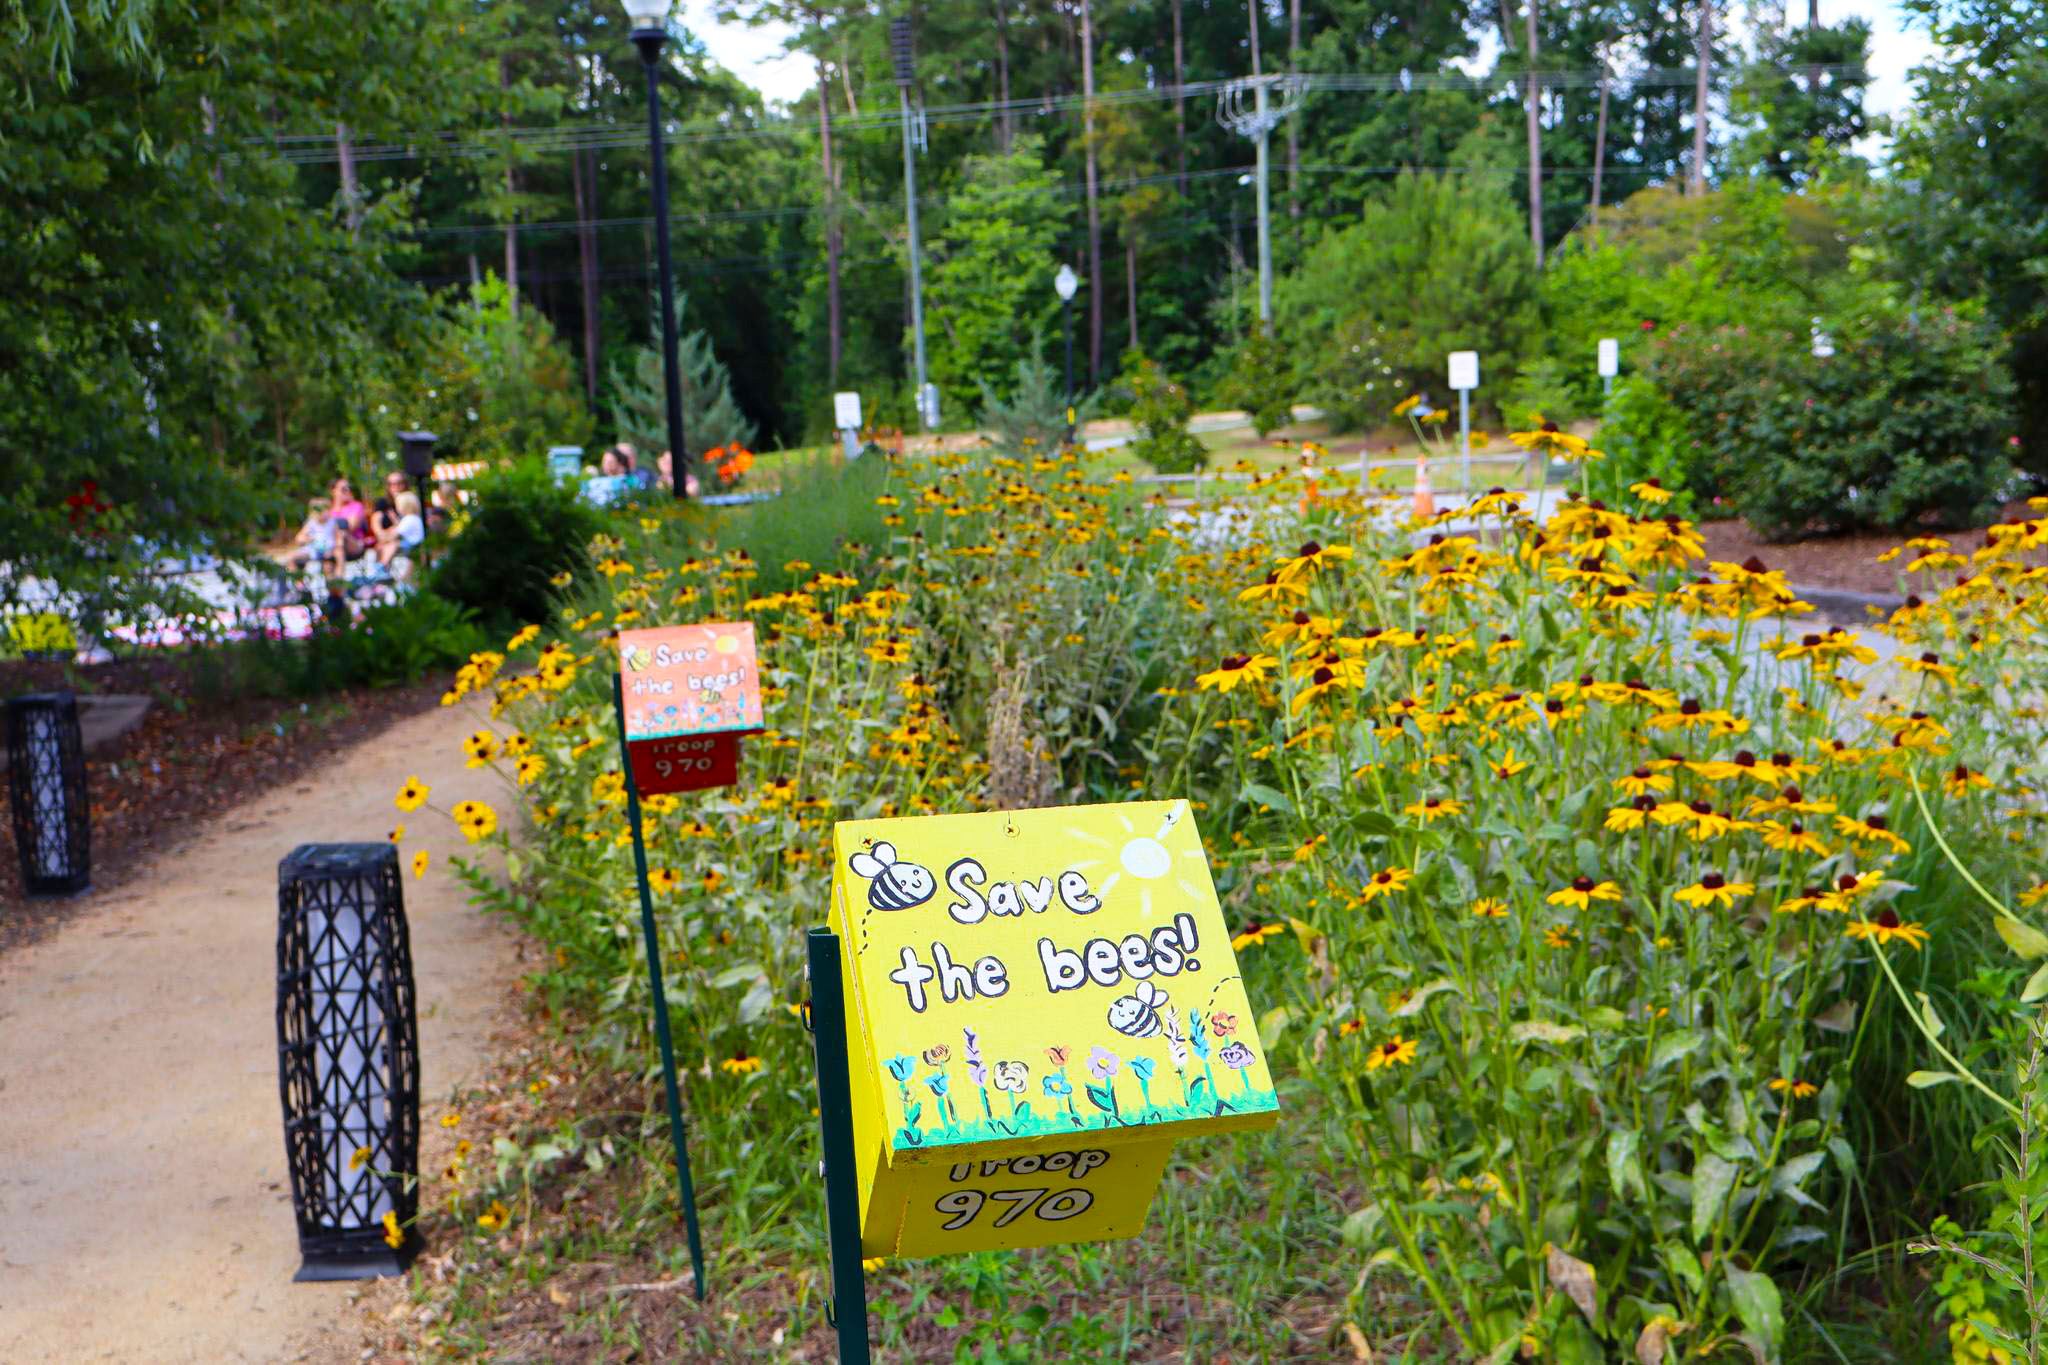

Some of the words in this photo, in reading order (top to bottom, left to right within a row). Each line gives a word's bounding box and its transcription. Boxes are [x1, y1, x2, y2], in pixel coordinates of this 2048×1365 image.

[656, 643, 708, 667] Save
[632, 677, 674, 696] the
[687, 665, 747, 692] bees!
[655, 757, 712, 778] 970
[945, 857, 1102, 924] Save
[890, 942, 1010, 1013] the
[1037, 912, 1201, 993] bees!
[935, 1187, 1094, 1230] 970
